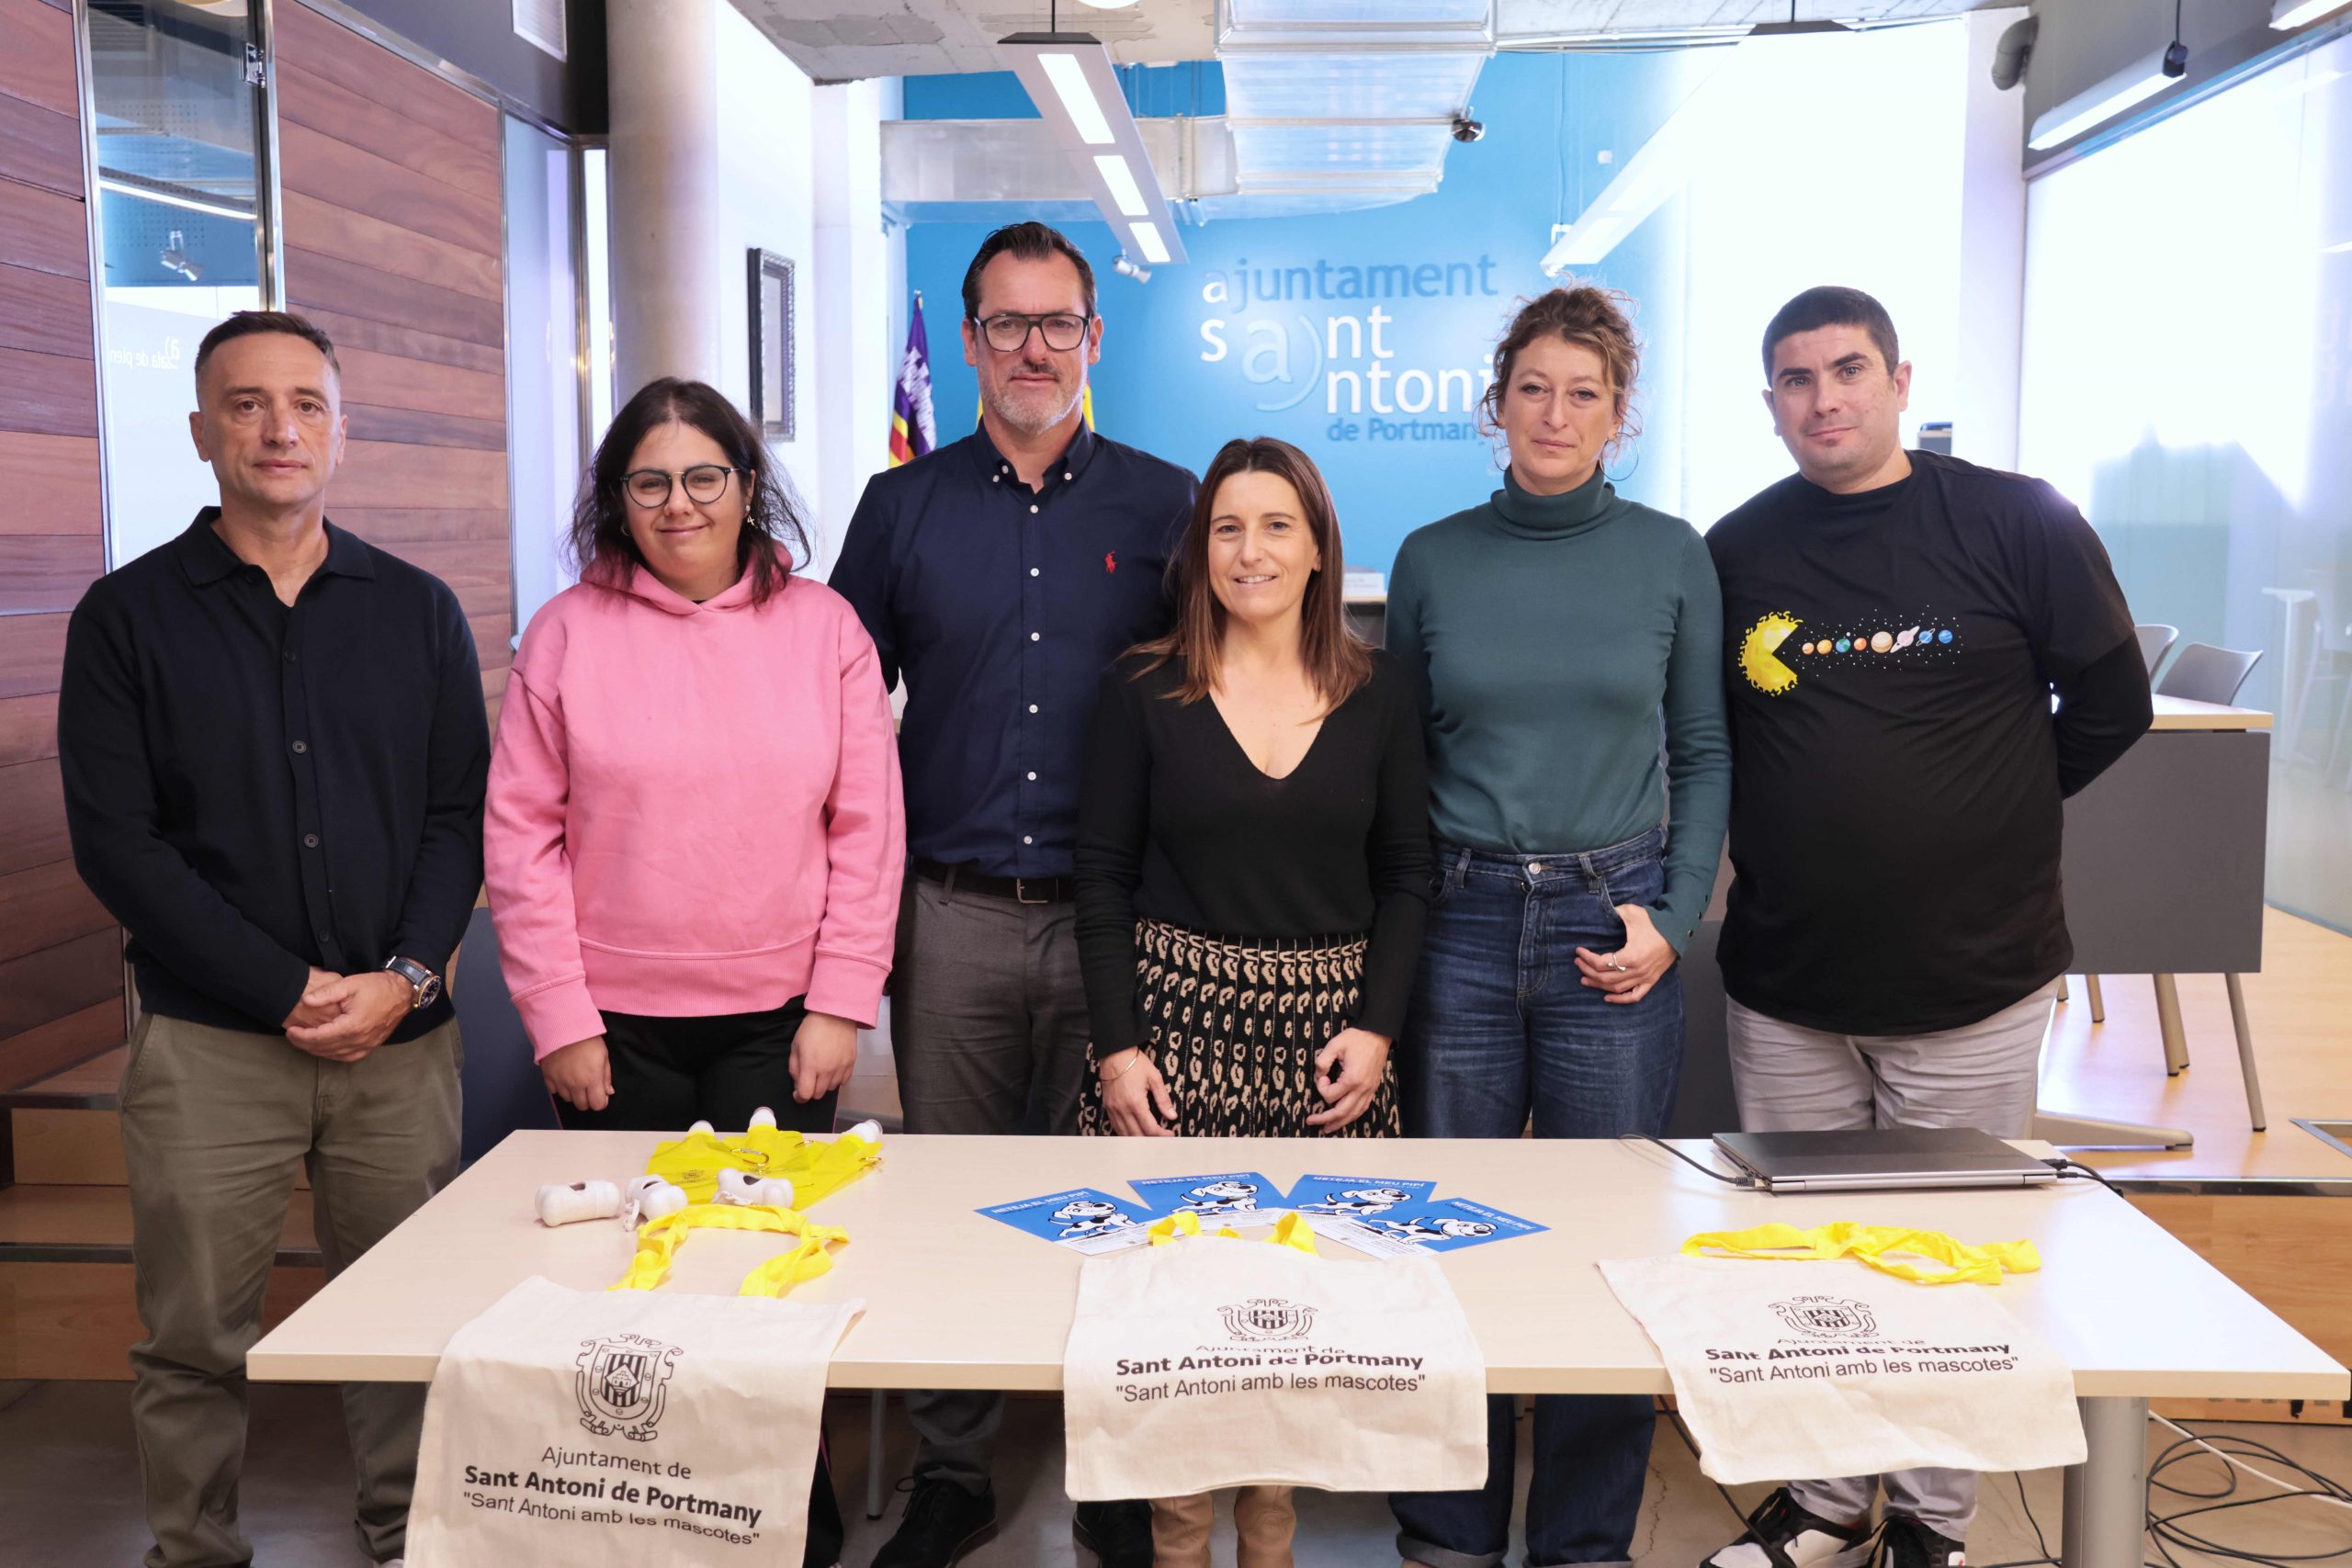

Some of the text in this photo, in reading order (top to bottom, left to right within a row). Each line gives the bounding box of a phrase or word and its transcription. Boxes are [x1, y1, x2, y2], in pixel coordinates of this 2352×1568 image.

[1201, 254, 1498, 314] ajuntament
[1327, 418, 1360, 442] de
[1313, 1176, 1356, 1184] NETEJA
[1195, 1345, 1317, 1354] Ajuament
[1705, 1348, 1761, 1360] Sant
[1768, 1346, 1850, 1360] Antoni
[1890, 1344, 2010, 1355] Portmany
[1116, 1353, 1423, 1376] Sant Antoni de Portmany
[1710, 1356, 2019, 1383] "Sant Antoni amb les mascotes"
[1116, 1372, 1426, 1403] "Sant Antoni amb les mascotes"
[541, 1447, 692, 1480] Ajuntament de
[464, 1465, 763, 1529] Sant Antoni de Portmany
[464, 1491, 761, 1545] "Sant Antoni amb les mascotes"
